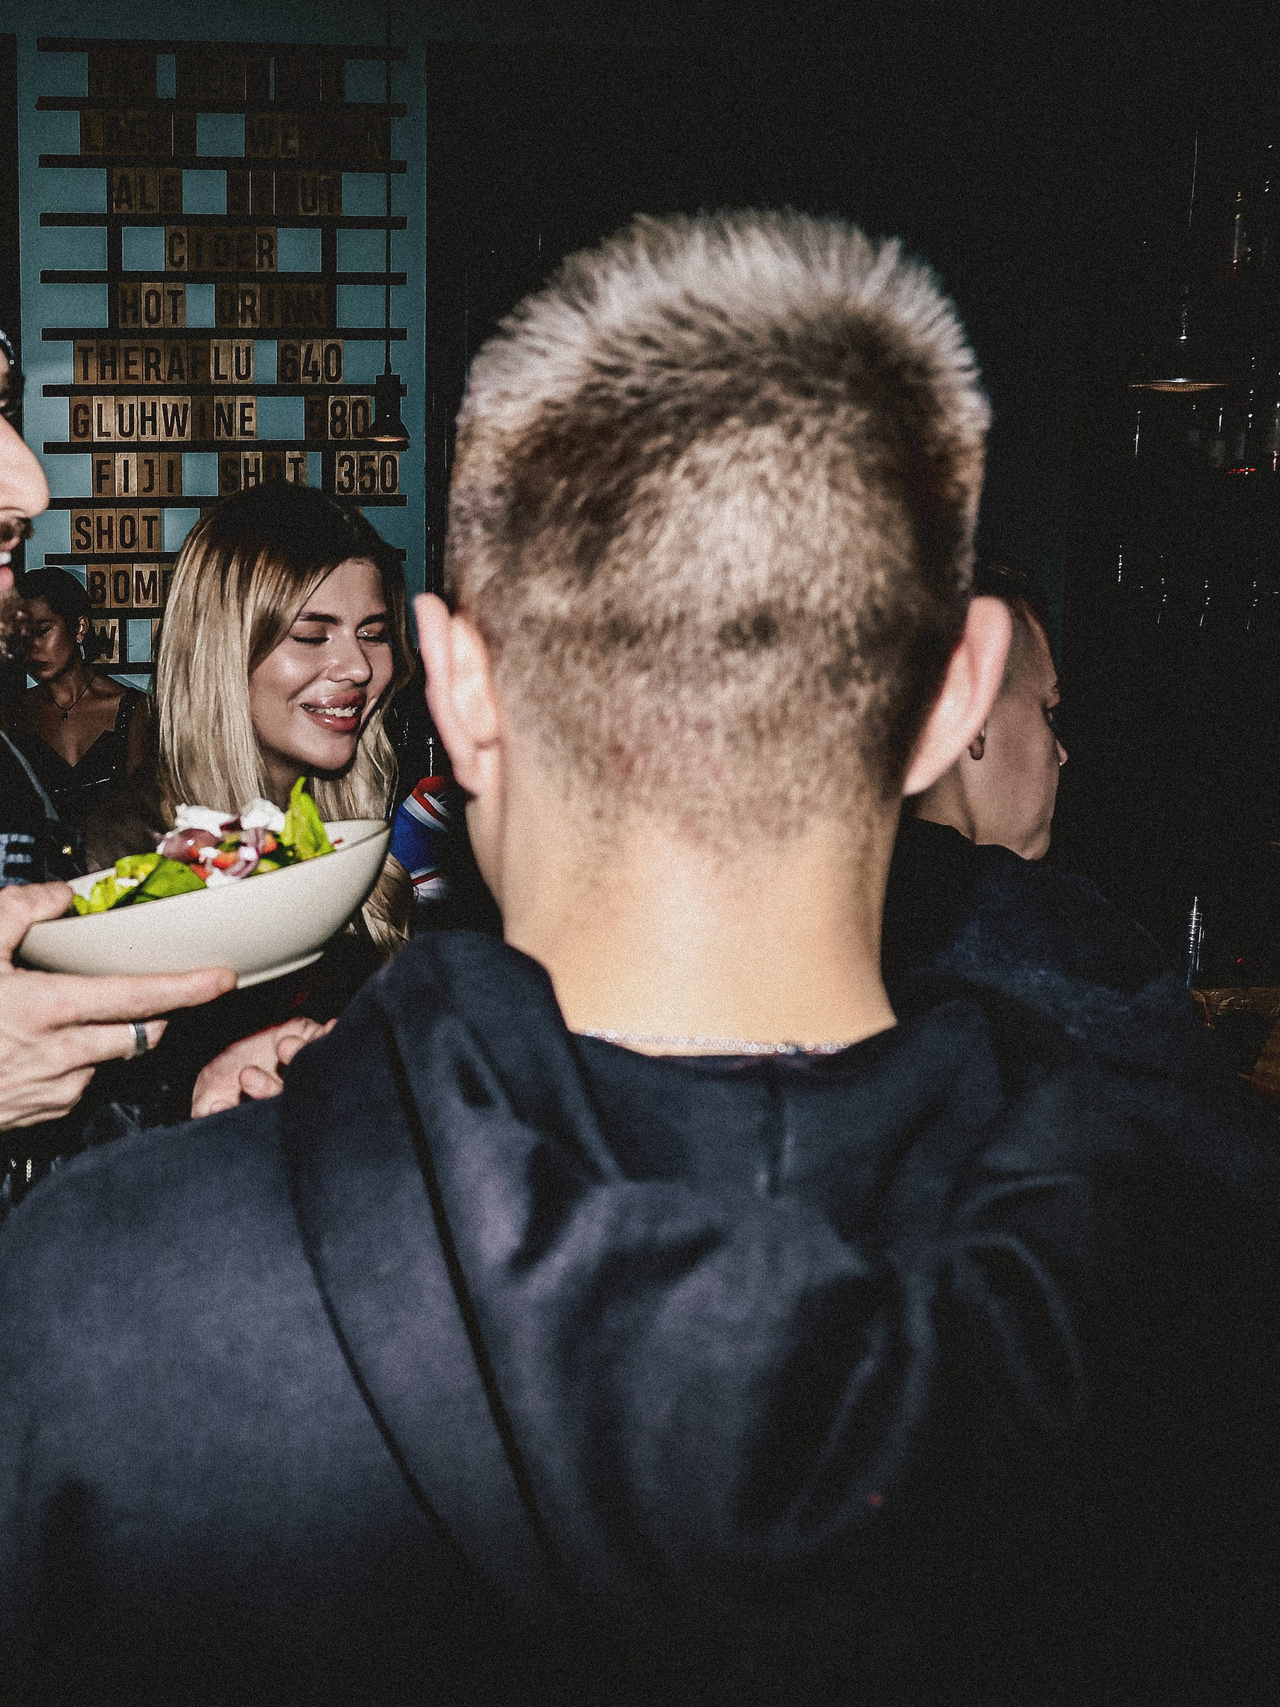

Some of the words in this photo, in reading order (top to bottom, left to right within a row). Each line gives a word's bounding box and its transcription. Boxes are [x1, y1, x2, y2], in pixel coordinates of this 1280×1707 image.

[115, 174, 180, 212] ALE
[230, 177, 340, 214] STOUT
[168, 232, 275, 268] CIDER
[122, 289, 184, 324] HOT
[221, 290, 328, 325] DRINK
[77, 346, 251, 381] THERAFLU
[279, 344, 342, 383] 640
[72, 403, 256, 438] GLUHWINE
[308, 400, 371, 438] 580
[96, 458, 174, 494] FIJI
[338, 455, 398, 494] 350
[75, 515, 158, 551] SHOT
